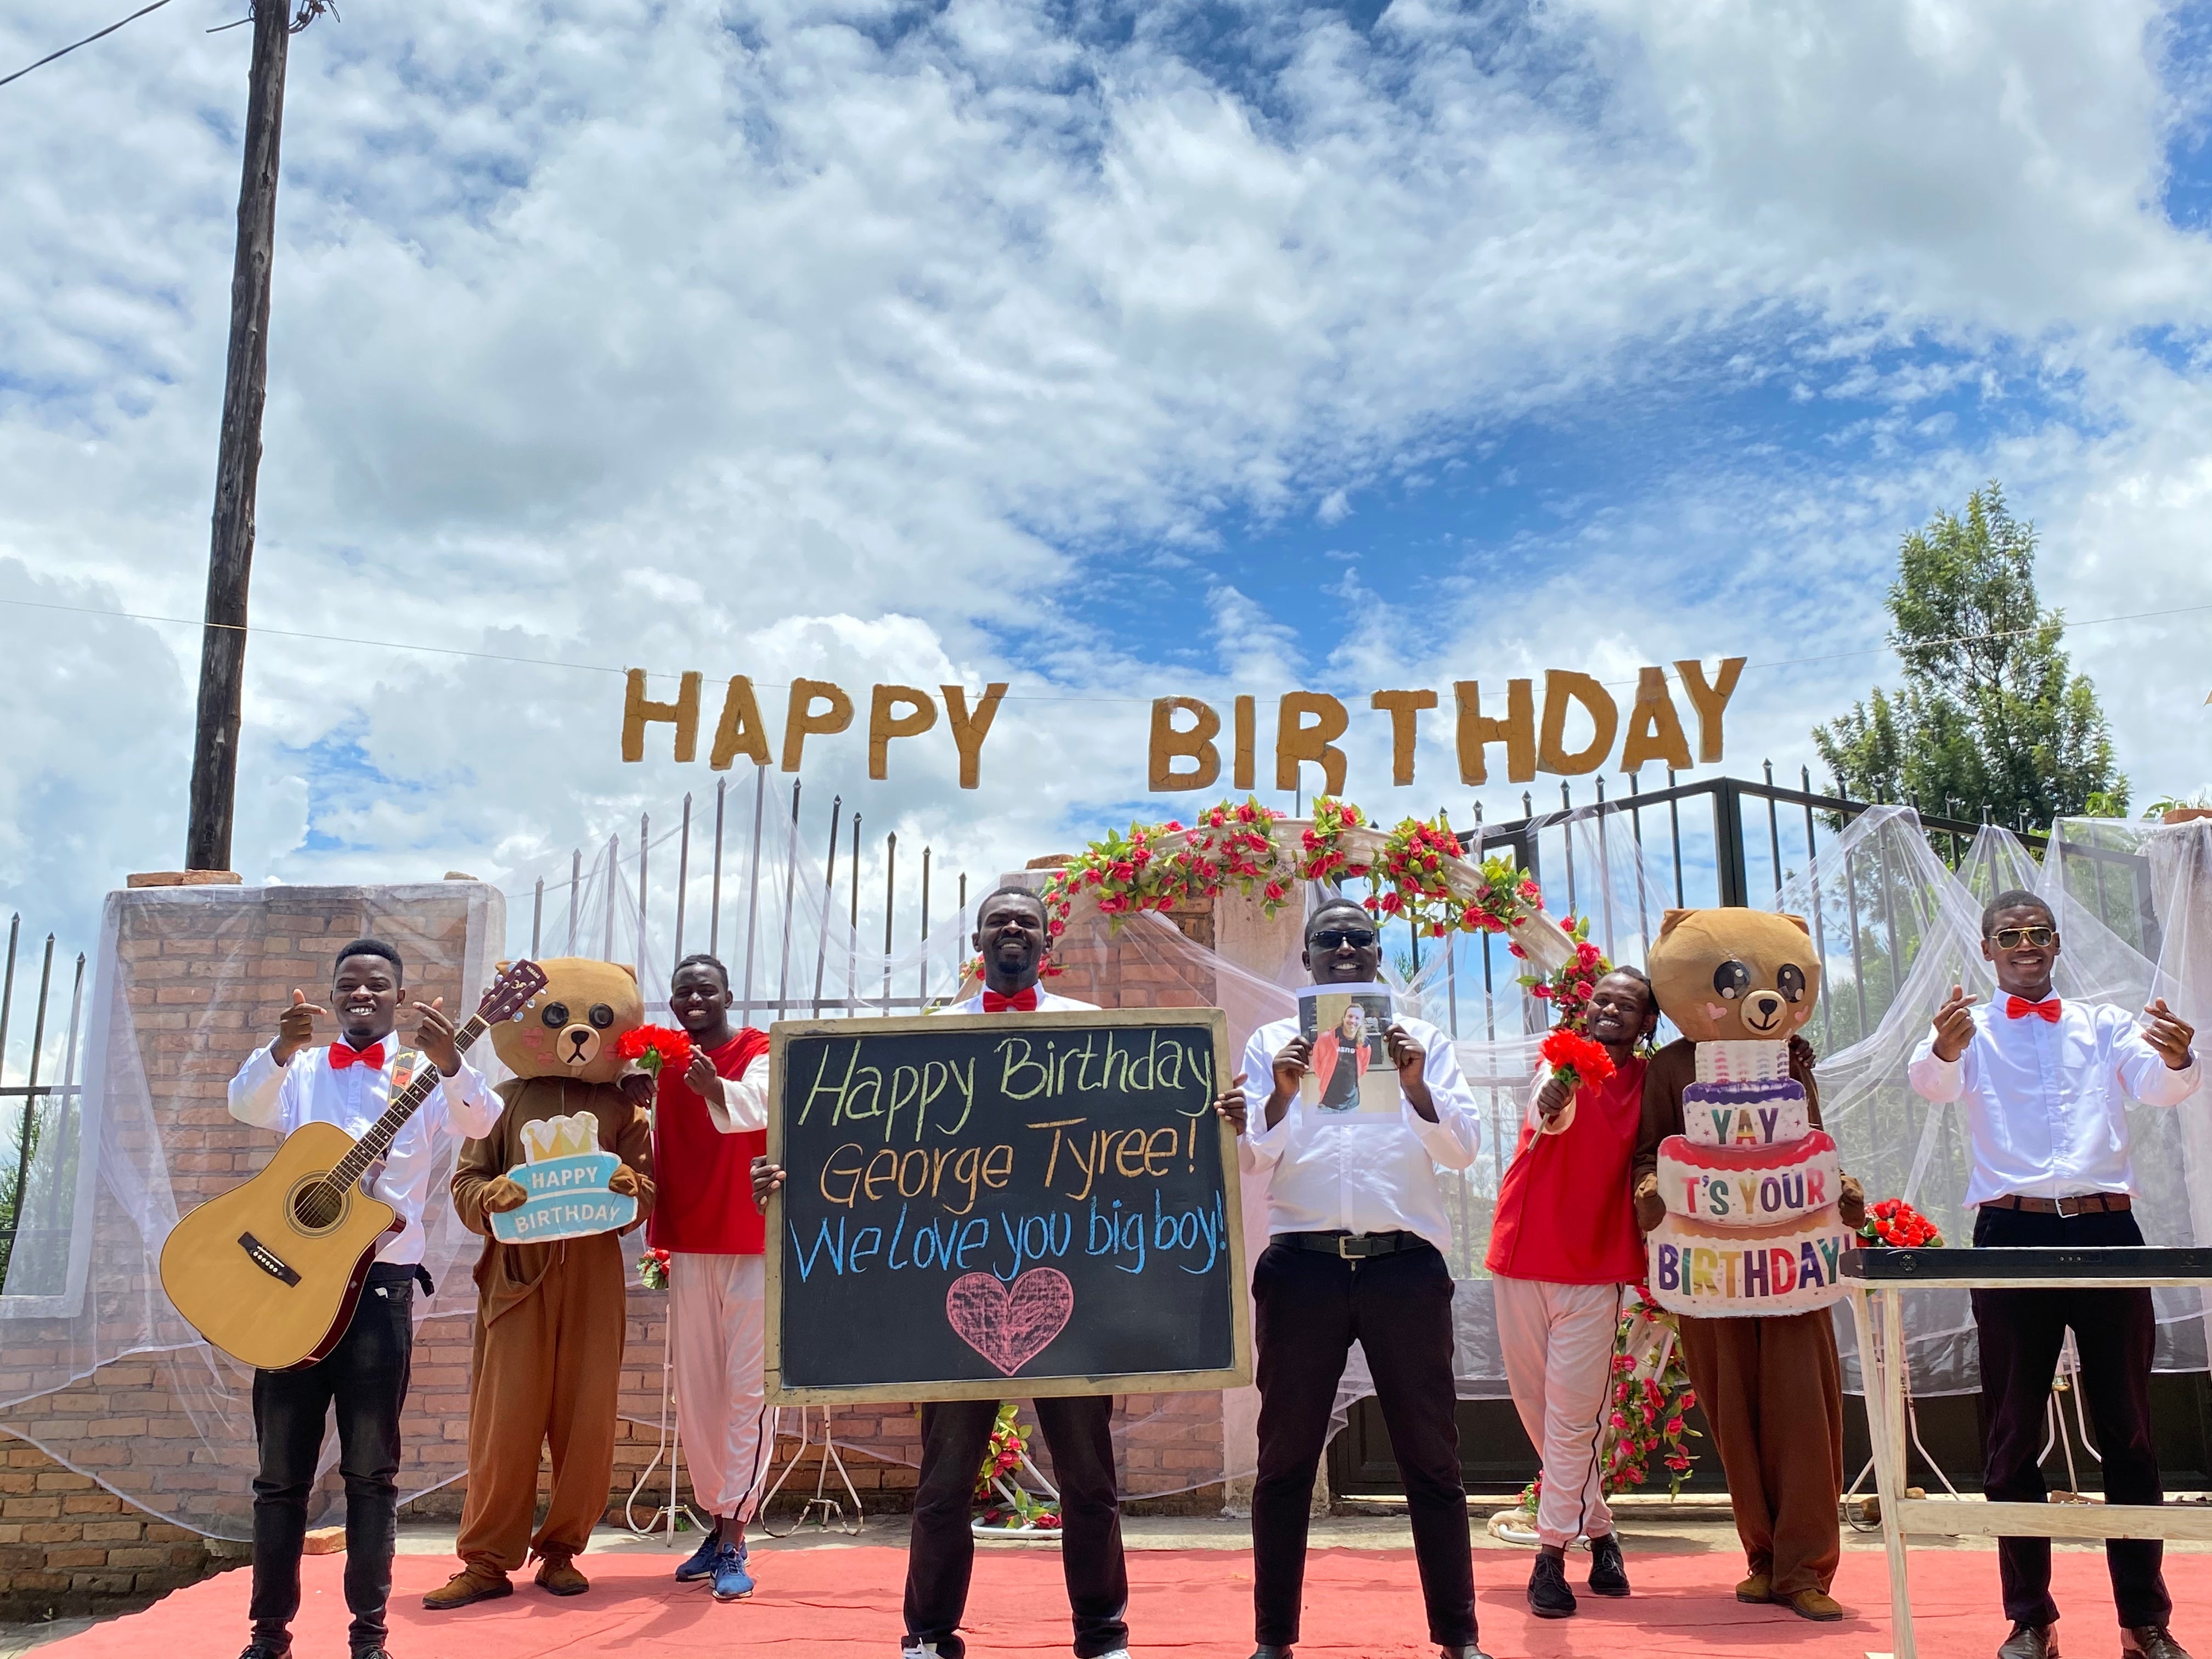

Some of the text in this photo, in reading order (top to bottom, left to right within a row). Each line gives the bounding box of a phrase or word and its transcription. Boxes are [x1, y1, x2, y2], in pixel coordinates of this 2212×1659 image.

[621, 656, 1748, 796] HAPPY BIRTHDAY
[525, 965, 541, 980] YAMAHA
[798, 1030, 1212, 1142] Happy Birthday
[1711, 1108, 1778, 1144] YAY
[532, 1166, 598, 1189] HAPPY
[820, 1118, 1197, 1215] George Tyree!
[1740, 1169, 1826, 1214] YOUR
[515, 1204, 620, 1233] BIRTHDAY
[789, 1216, 882, 1283] We
[993, 1211, 1072, 1282] you
[1086, 1195, 1146, 1274] big
[1155, 1189, 1227, 1274] boy!
